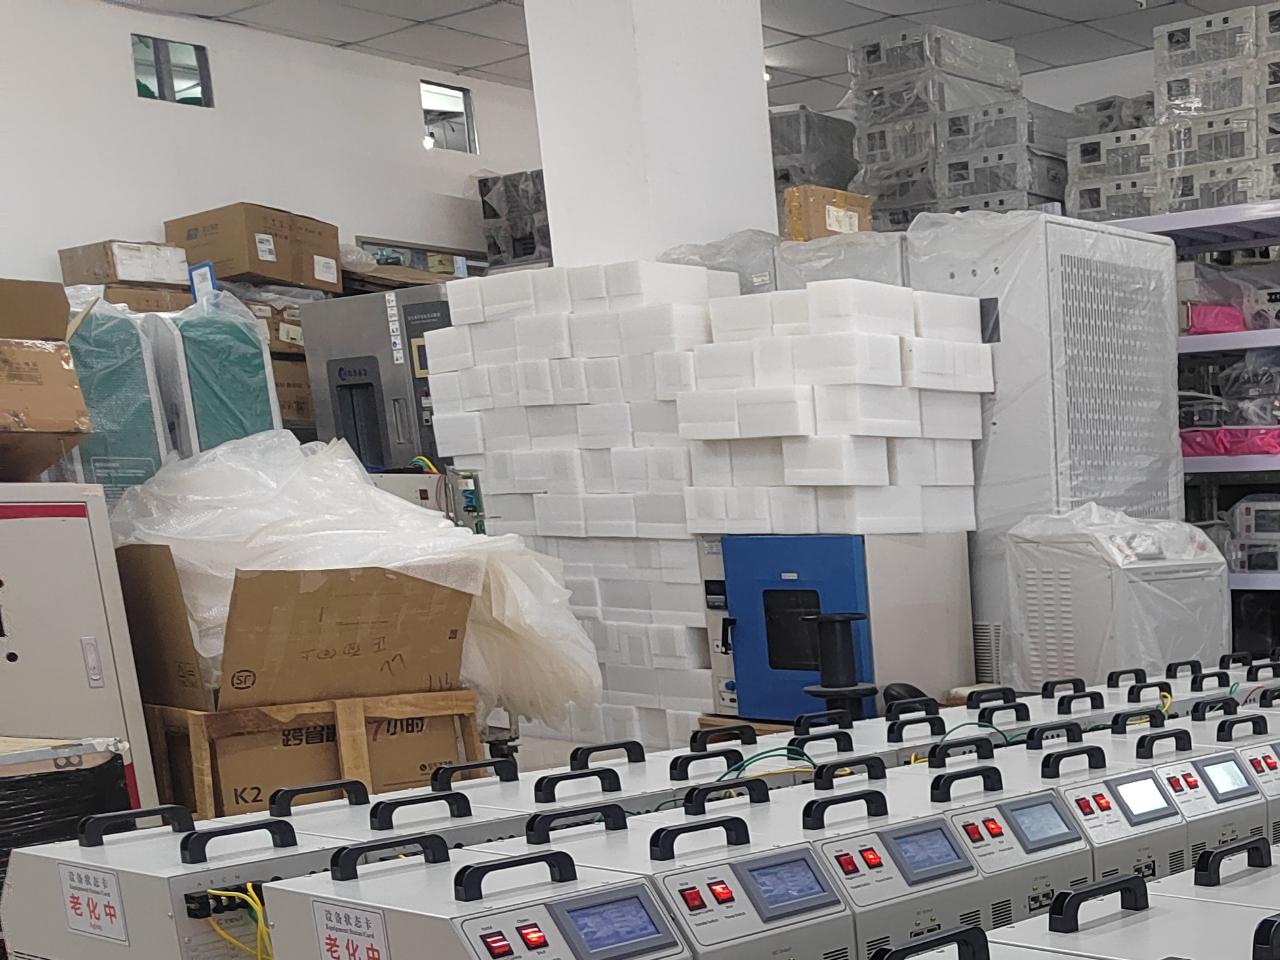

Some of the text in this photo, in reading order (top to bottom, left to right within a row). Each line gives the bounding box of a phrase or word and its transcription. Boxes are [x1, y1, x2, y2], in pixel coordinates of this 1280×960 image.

[233, 786, 264, 805] K2
[69, 893, 117, 925] 老化中
